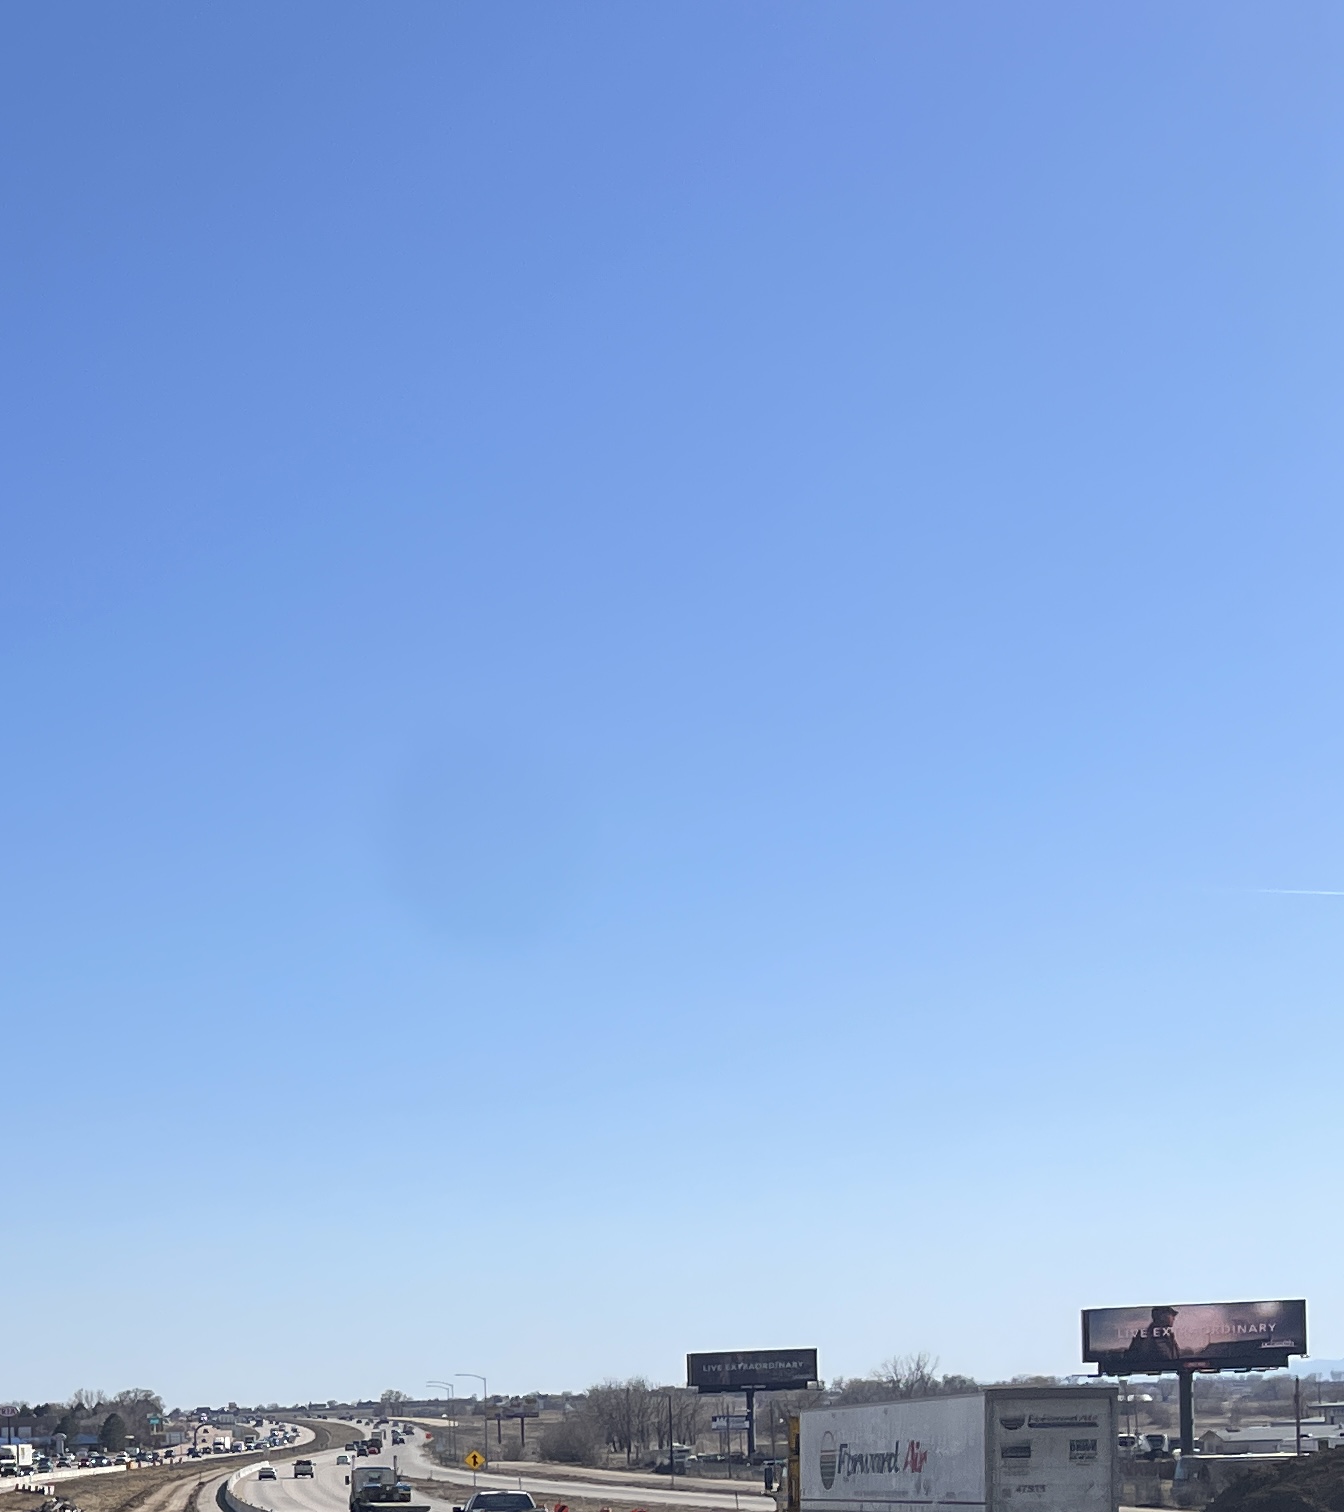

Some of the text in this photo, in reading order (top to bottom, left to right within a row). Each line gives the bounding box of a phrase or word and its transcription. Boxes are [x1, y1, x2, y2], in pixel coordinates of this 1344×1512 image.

[1118, 1327, 1148, 1338] LIVE
[702, 1361, 804, 1372] LIVE EXTRAORDINARY
[837, 1439, 928, 1476] Forward Air
